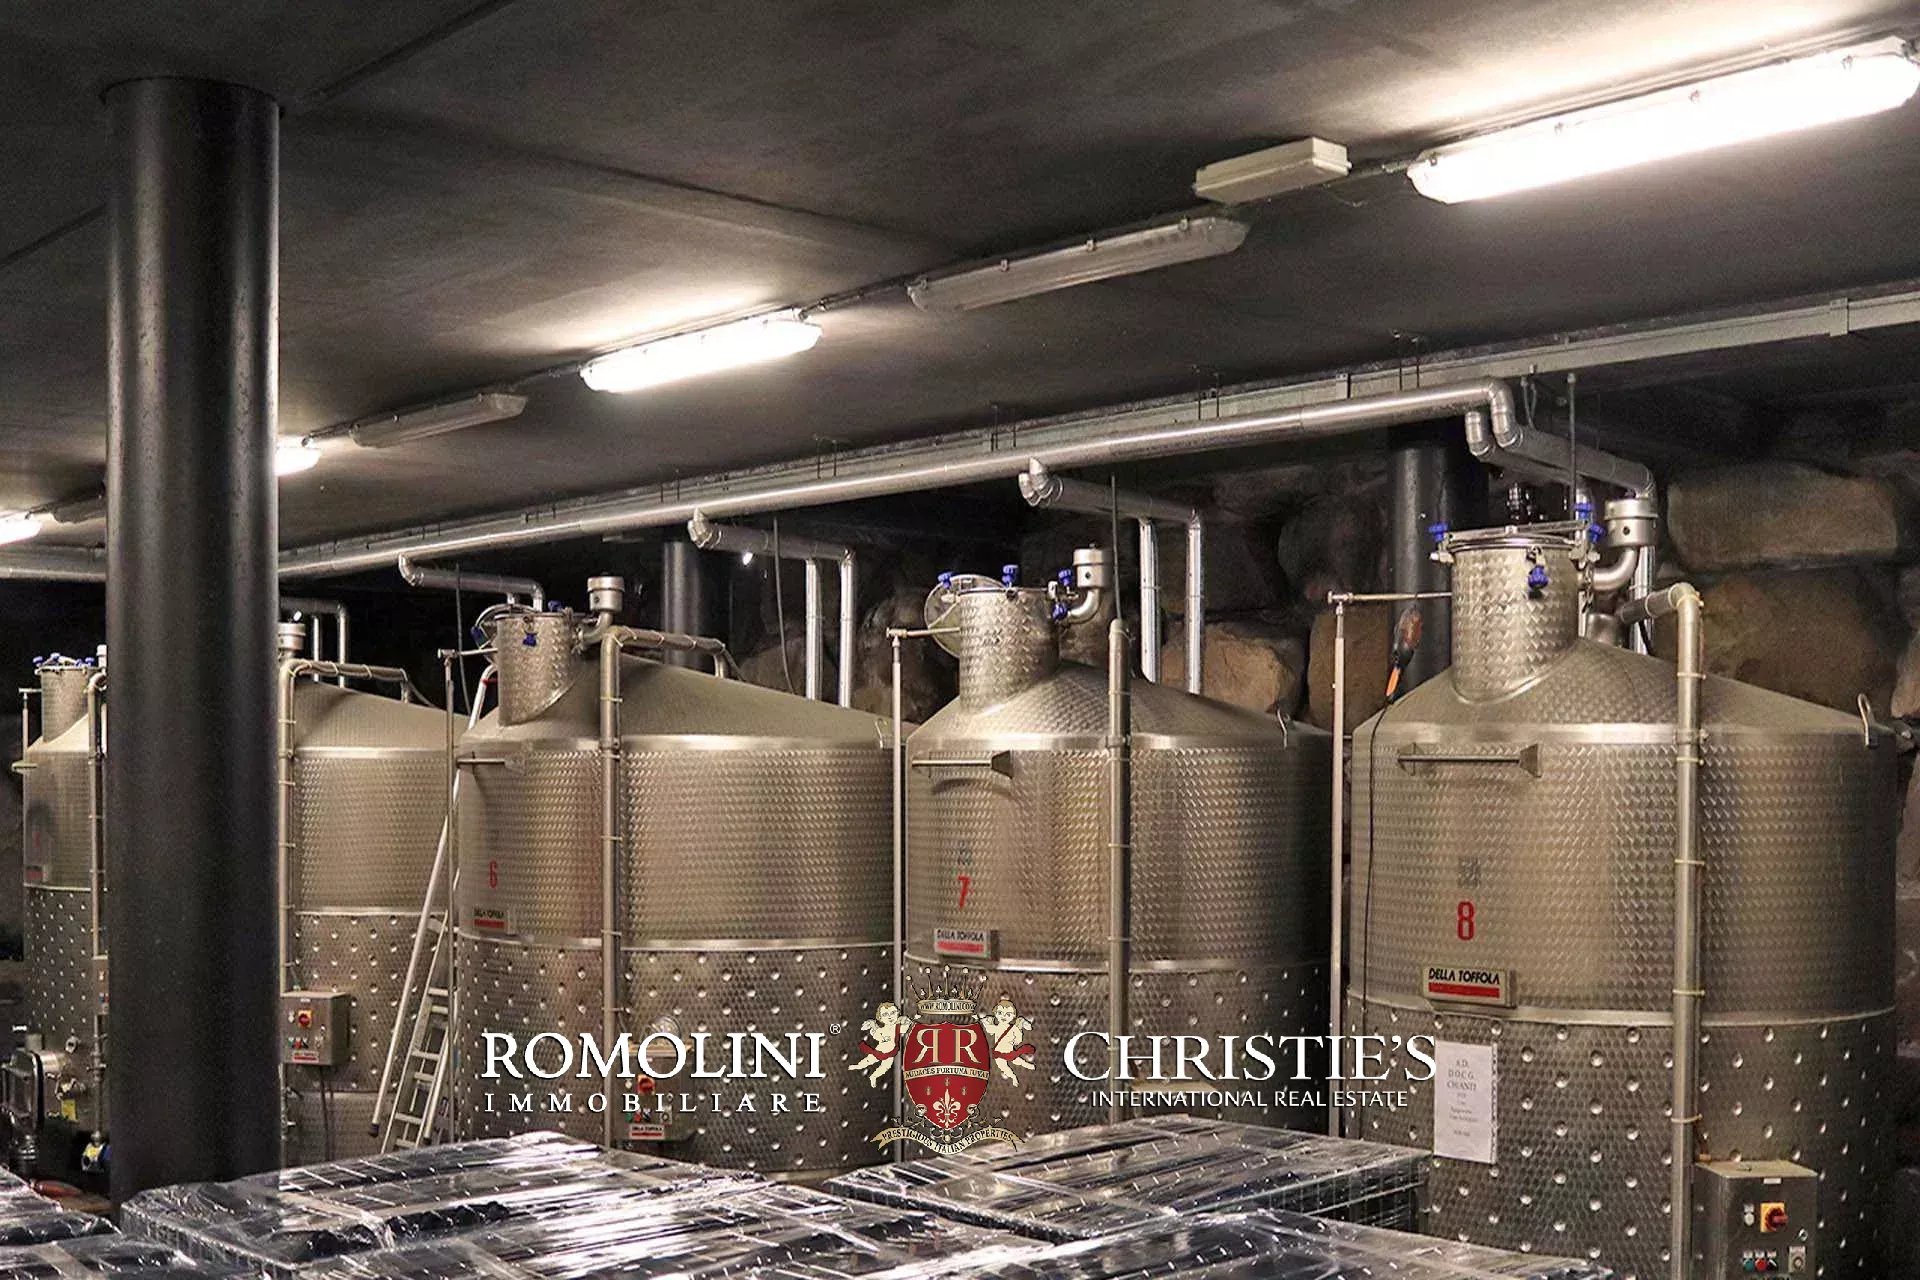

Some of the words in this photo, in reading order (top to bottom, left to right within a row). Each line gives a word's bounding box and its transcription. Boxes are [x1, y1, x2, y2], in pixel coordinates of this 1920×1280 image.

[488, 860, 498, 889] 6
[957, 875, 971, 911] 7
[1456, 900, 1475, 941] 8
[1428, 967, 1456, 981] DELLA
[1458, 970, 1500, 985] TOFFOLA
